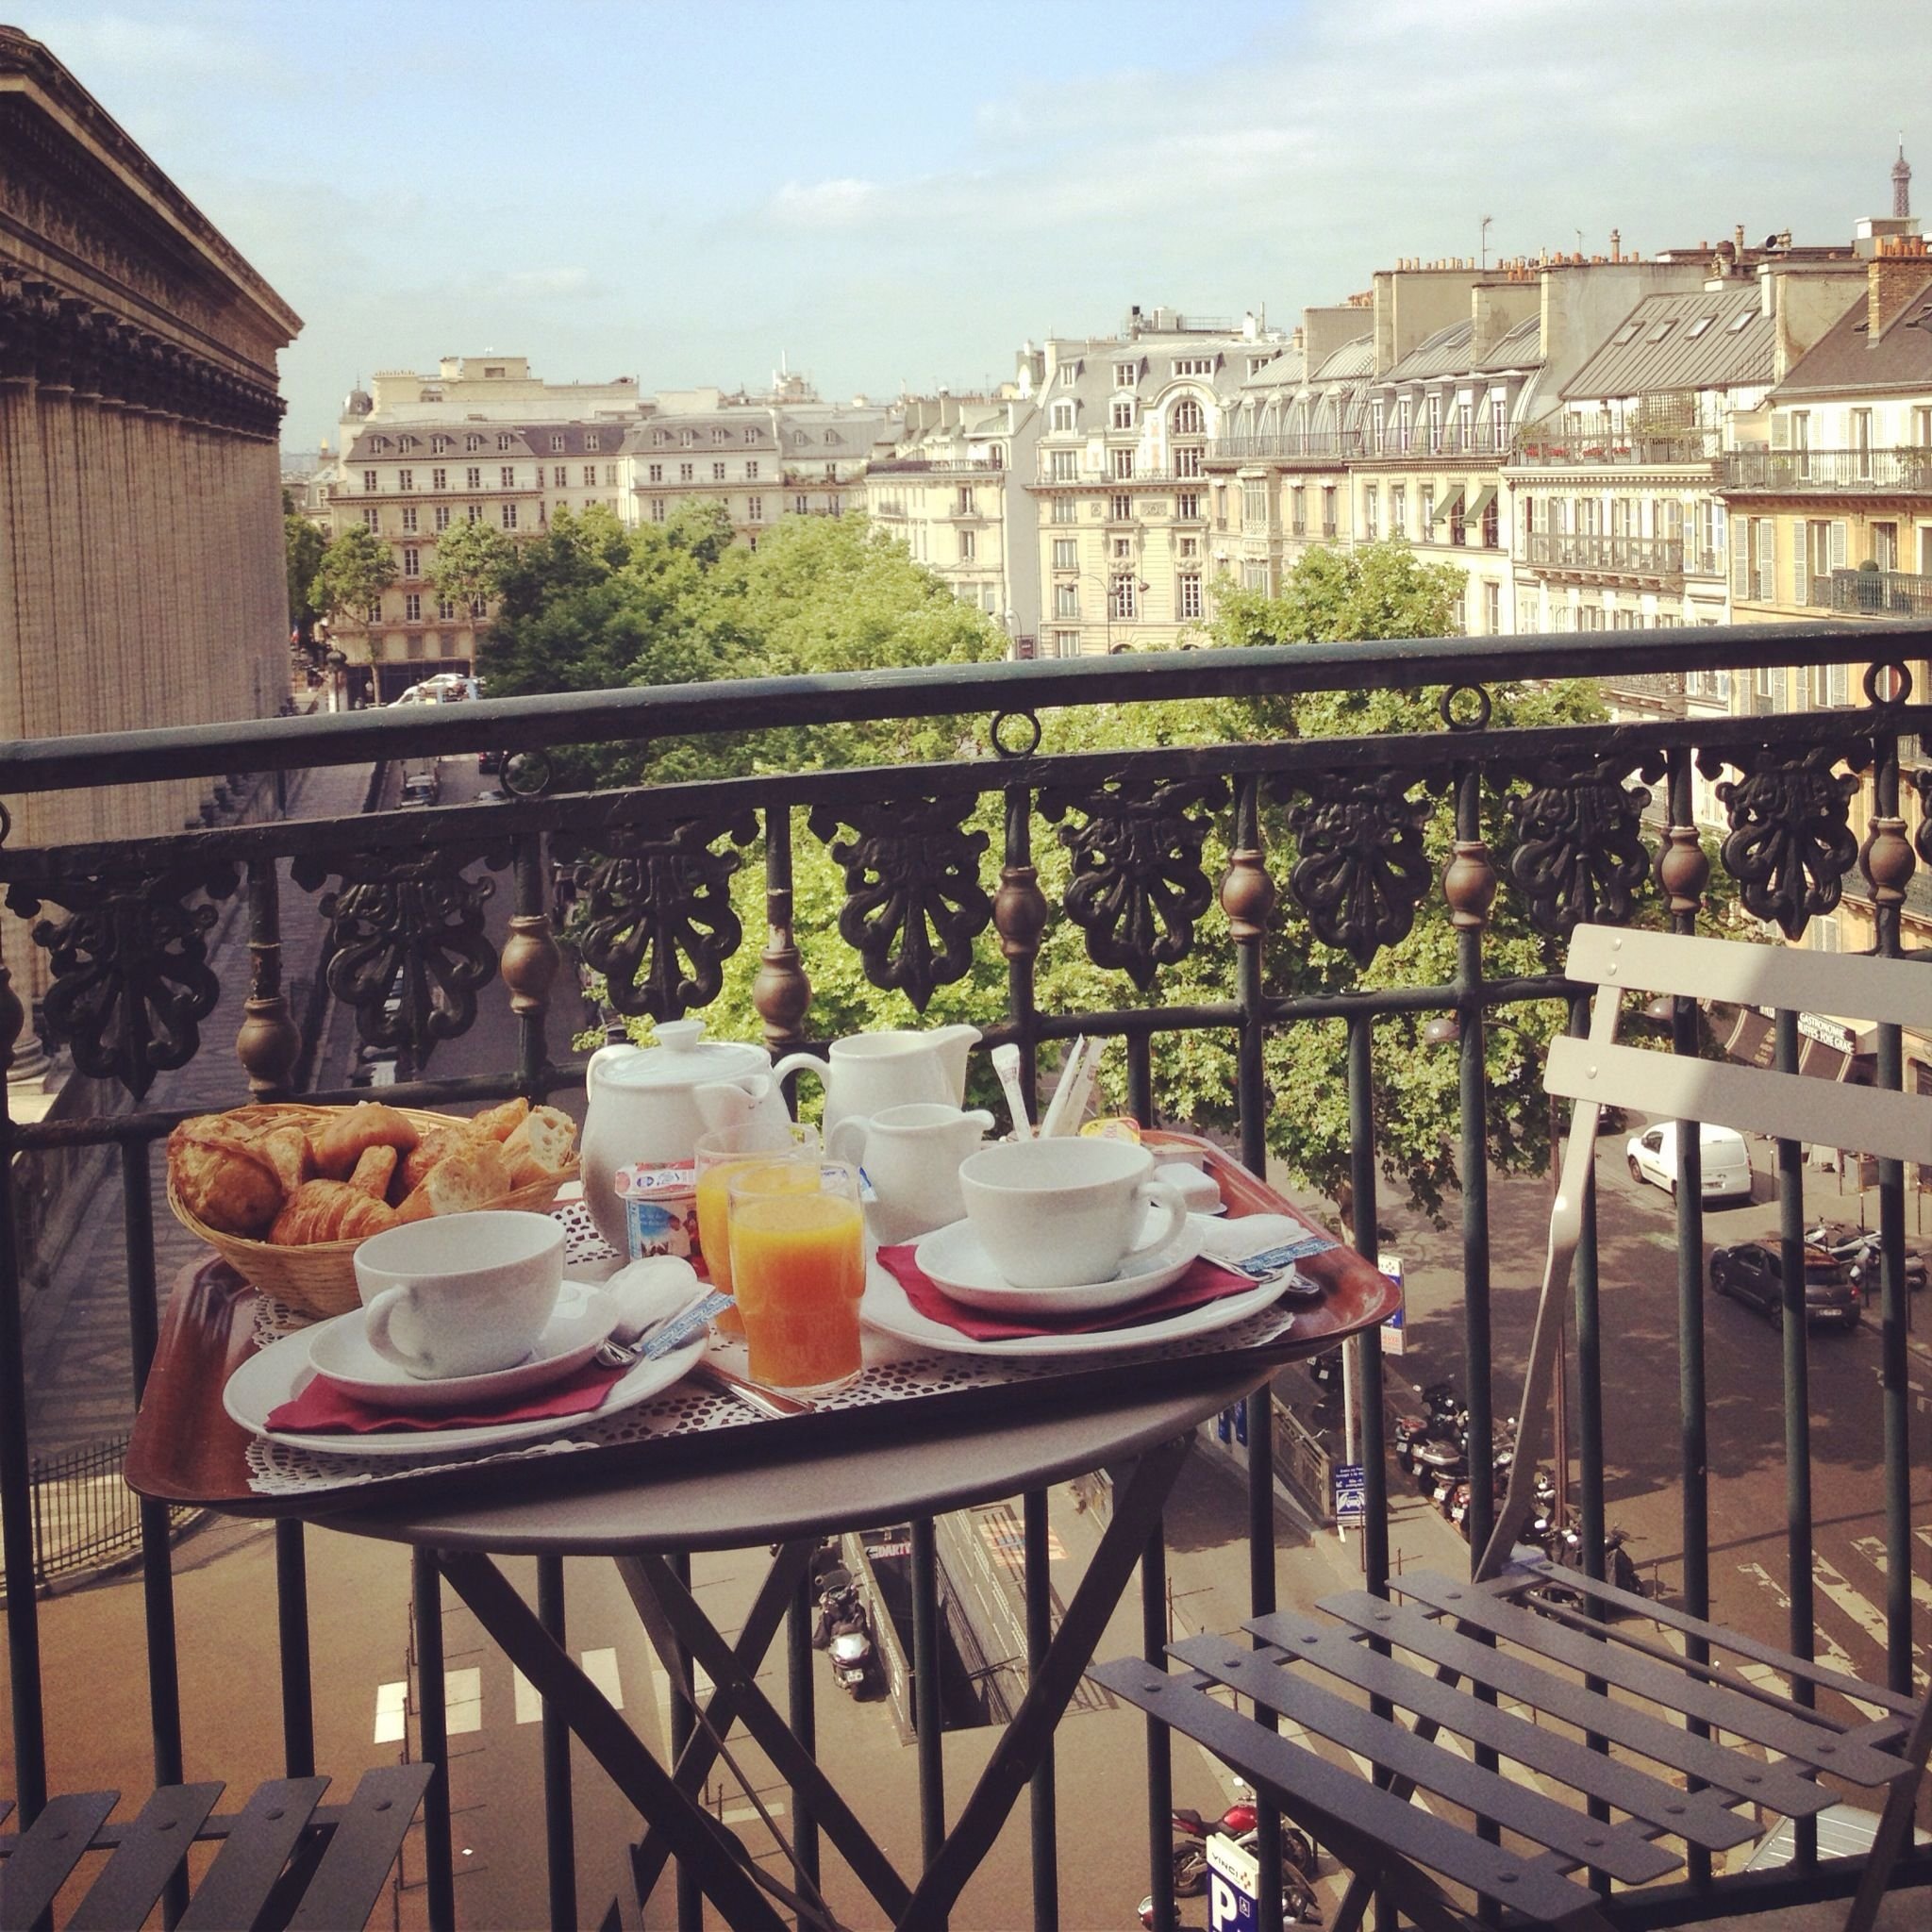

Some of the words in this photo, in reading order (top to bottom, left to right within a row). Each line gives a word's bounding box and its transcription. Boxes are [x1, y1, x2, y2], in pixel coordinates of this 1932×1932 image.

[1799, 1012, 1846, 1040] GASTRONOMIE
[1835, 1038, 1852, 1054] GRAS
[877, 1541, 911, 1557] DARTY
[1211, 1852, 1239, 1877] VINCI
[1211, 1873, 1238, 1932] P
